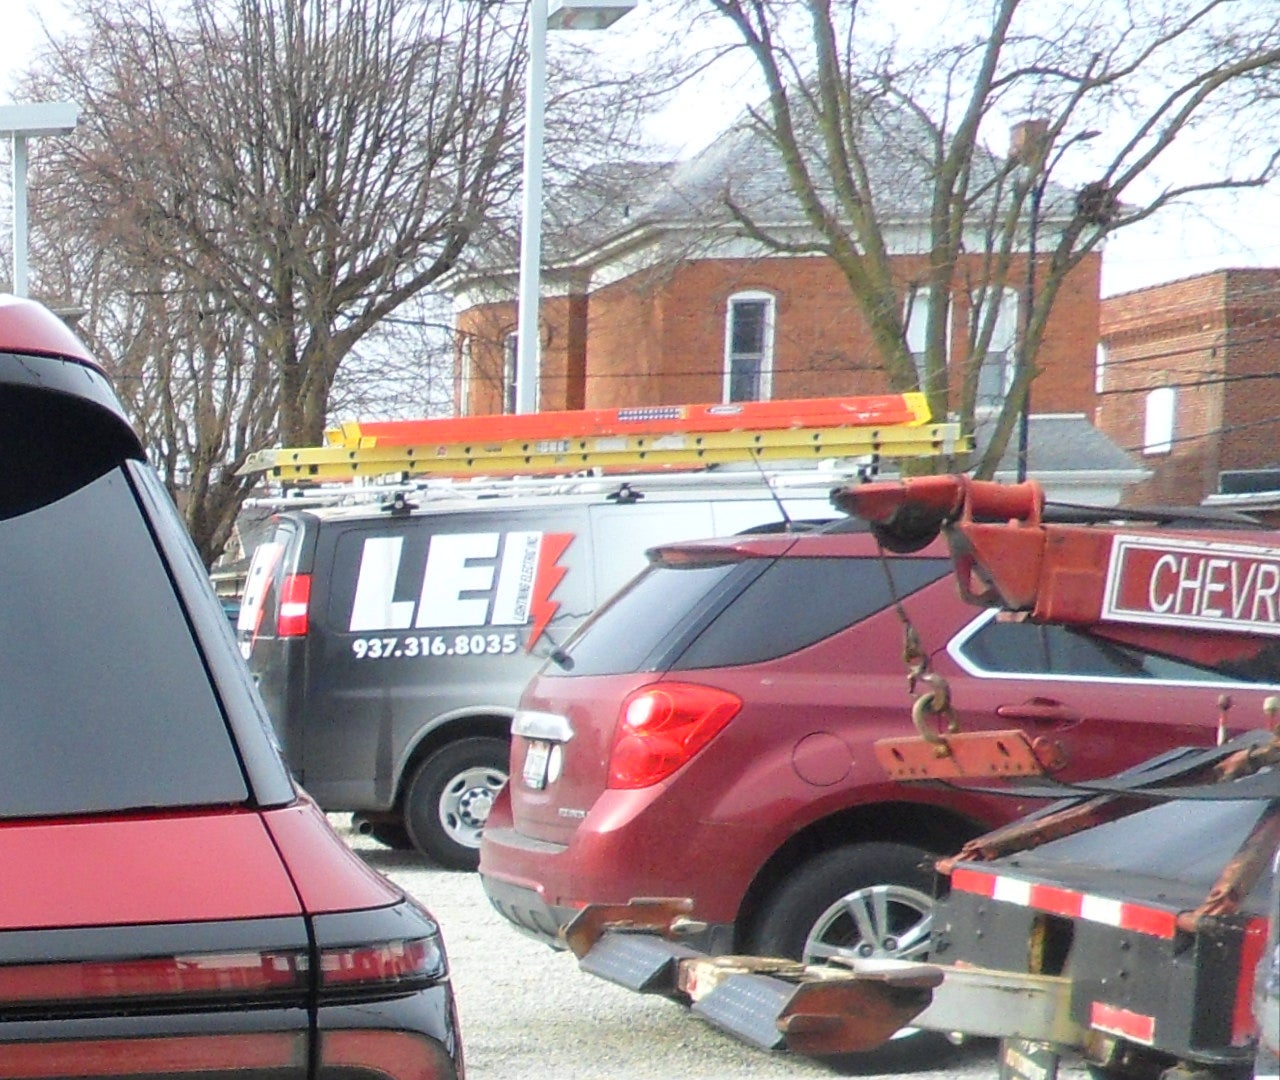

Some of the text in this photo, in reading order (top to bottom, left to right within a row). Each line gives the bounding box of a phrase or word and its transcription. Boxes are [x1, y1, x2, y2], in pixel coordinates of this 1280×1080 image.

[349, 531, 544, 632] LEI
[1148, 554, 1280, 622] CHEVR
[352, 634, 518, 659] 937.316.8035
